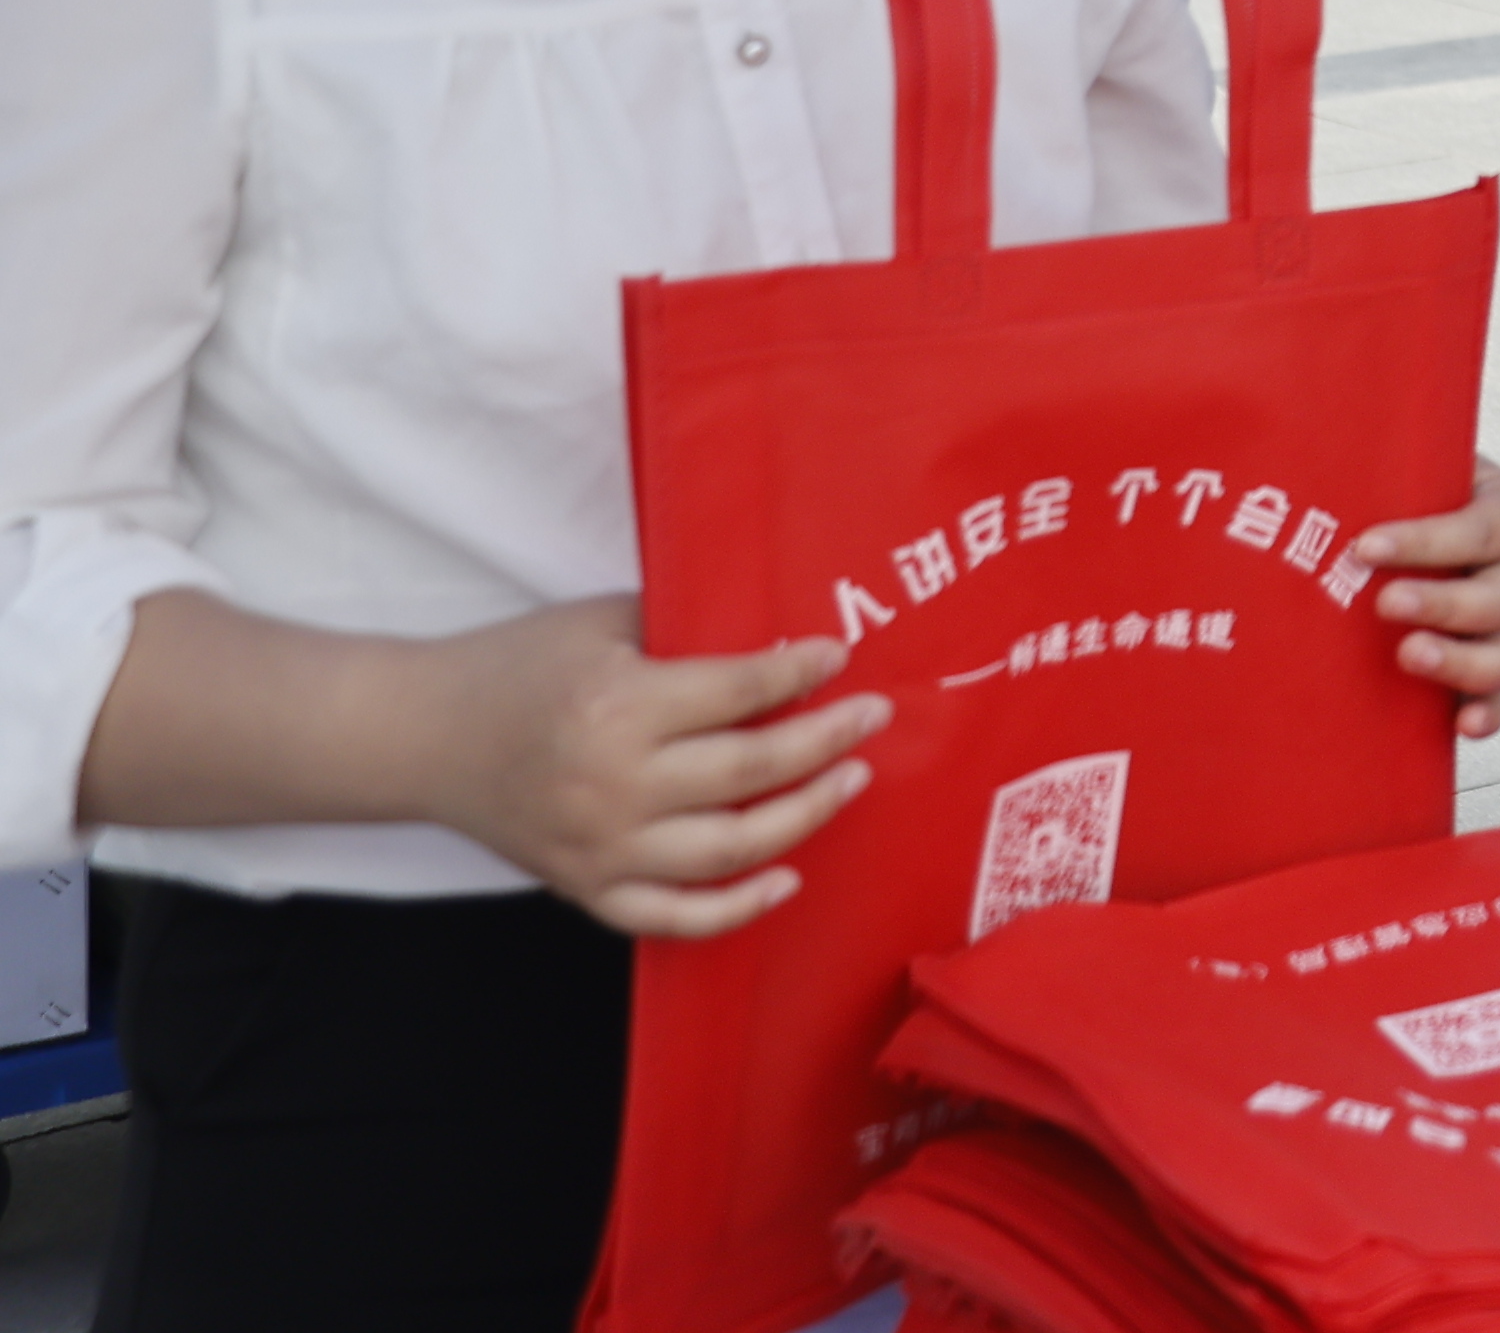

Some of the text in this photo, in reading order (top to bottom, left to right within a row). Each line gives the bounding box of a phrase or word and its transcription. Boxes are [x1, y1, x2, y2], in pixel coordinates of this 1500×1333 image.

[832, 467, 1376, 651] 人讲安全 个个会应急
